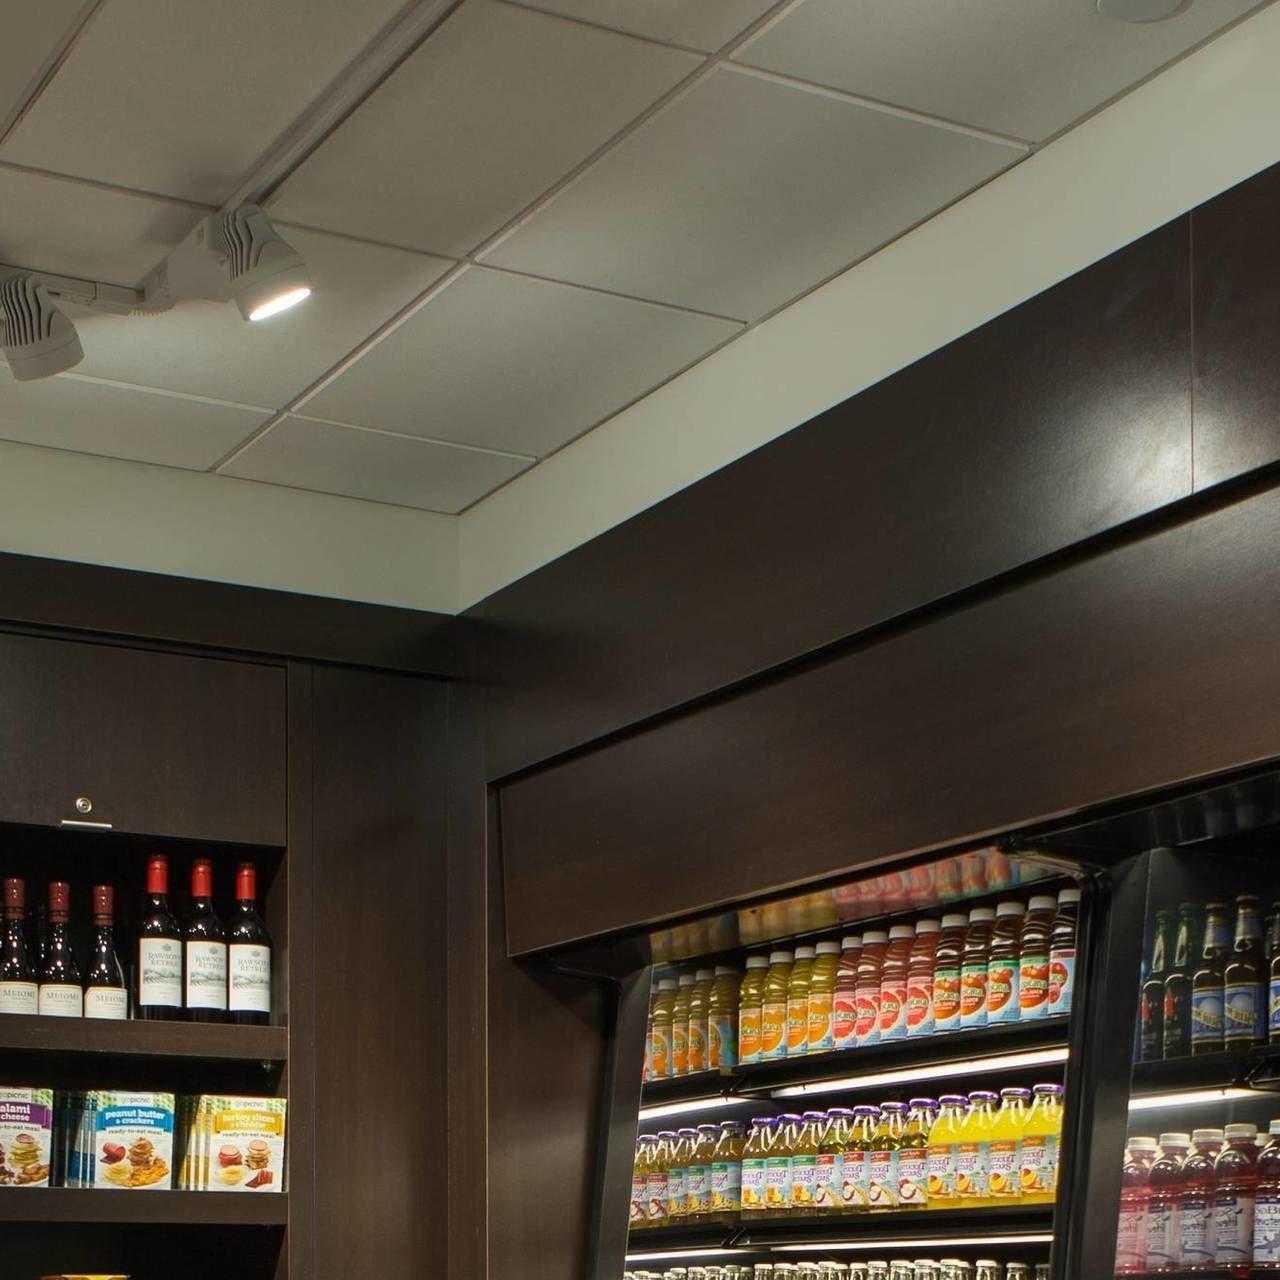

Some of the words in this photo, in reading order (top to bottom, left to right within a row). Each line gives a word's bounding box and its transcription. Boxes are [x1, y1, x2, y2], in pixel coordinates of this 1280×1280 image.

[1, 1112, 30, 1122] cheese
[105, 1109, 137, 1120] peanut
[138, 1110, 166, 1120] butter
[222, 1113, 251, 1124] turkey
[252, 1114, 276, 1124] slices
[122, 1116, 155, 1126] crackers
